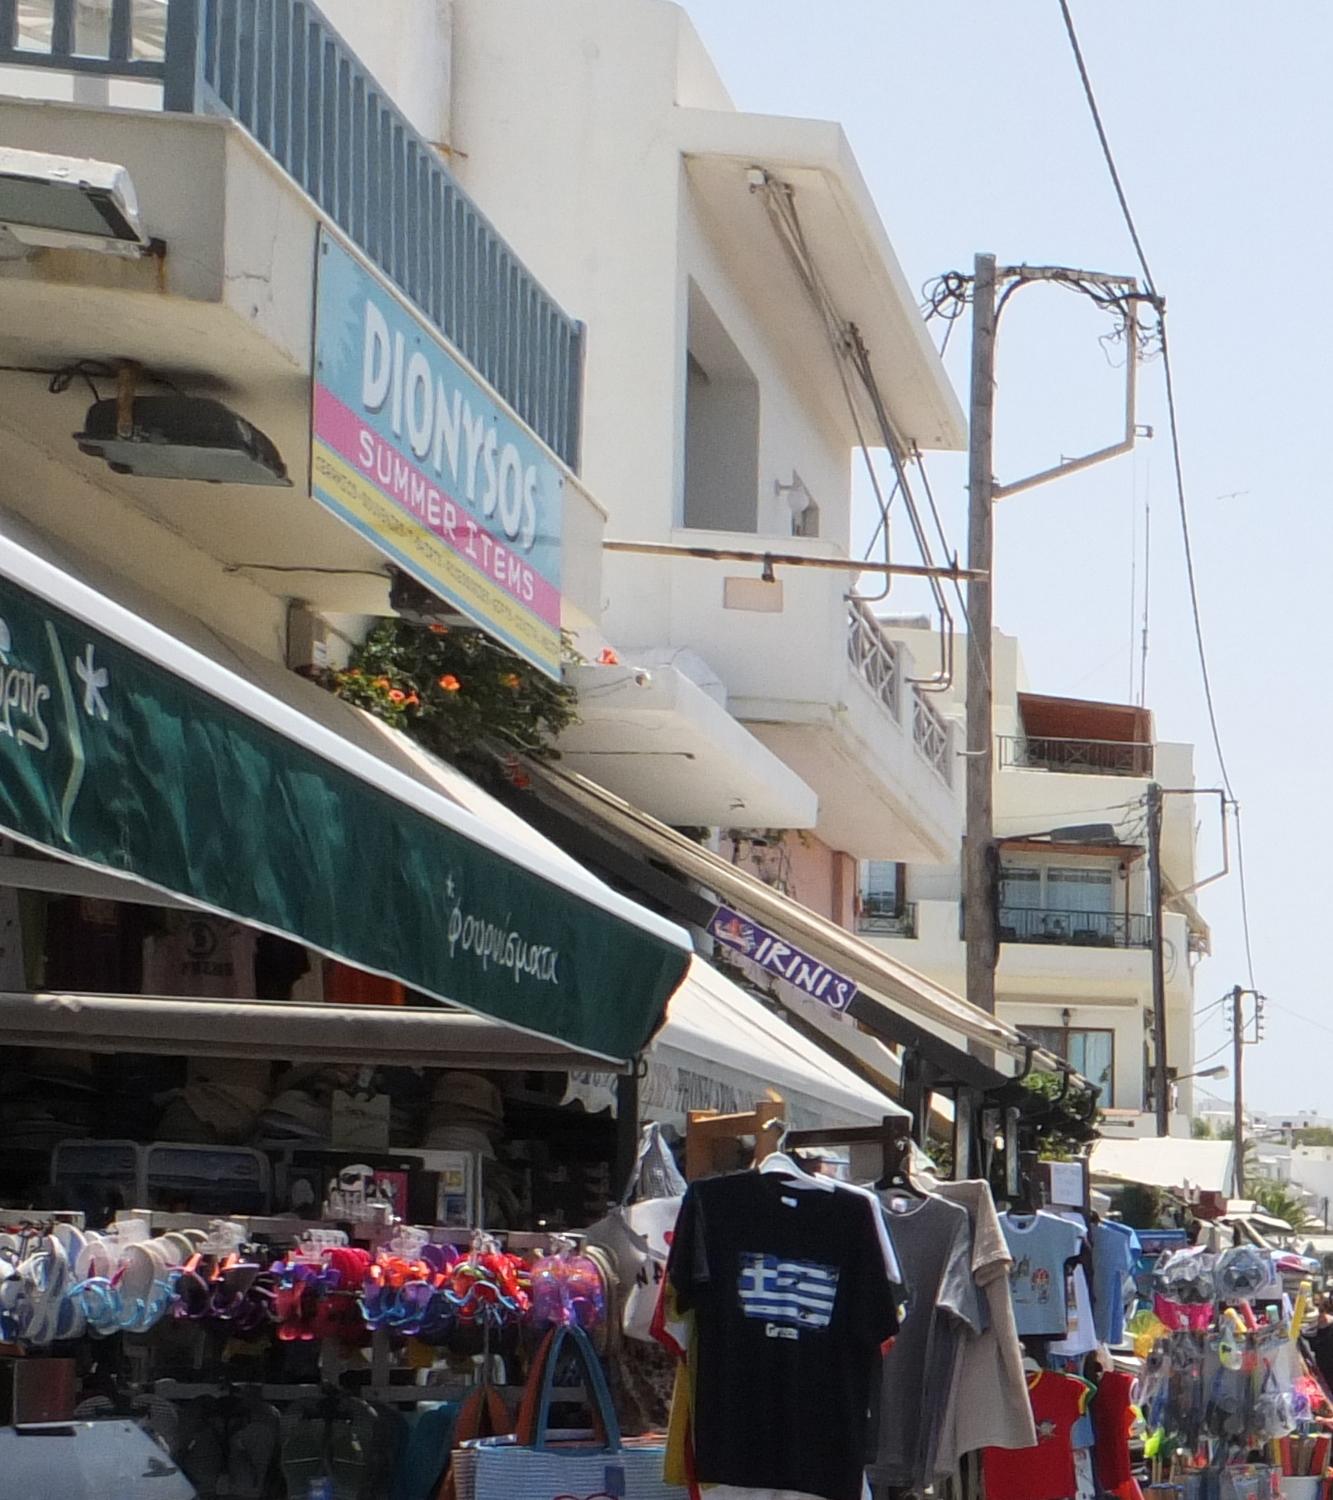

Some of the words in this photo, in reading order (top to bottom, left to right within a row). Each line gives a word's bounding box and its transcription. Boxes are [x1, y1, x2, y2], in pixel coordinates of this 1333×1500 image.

[362, 299, 537, 550] DIONYSOS
[359, 430, 457, 541] SUMMER
[465, 520, 534, 601] ITEMS
[754, 937, 849, 1009] IRINI'S
